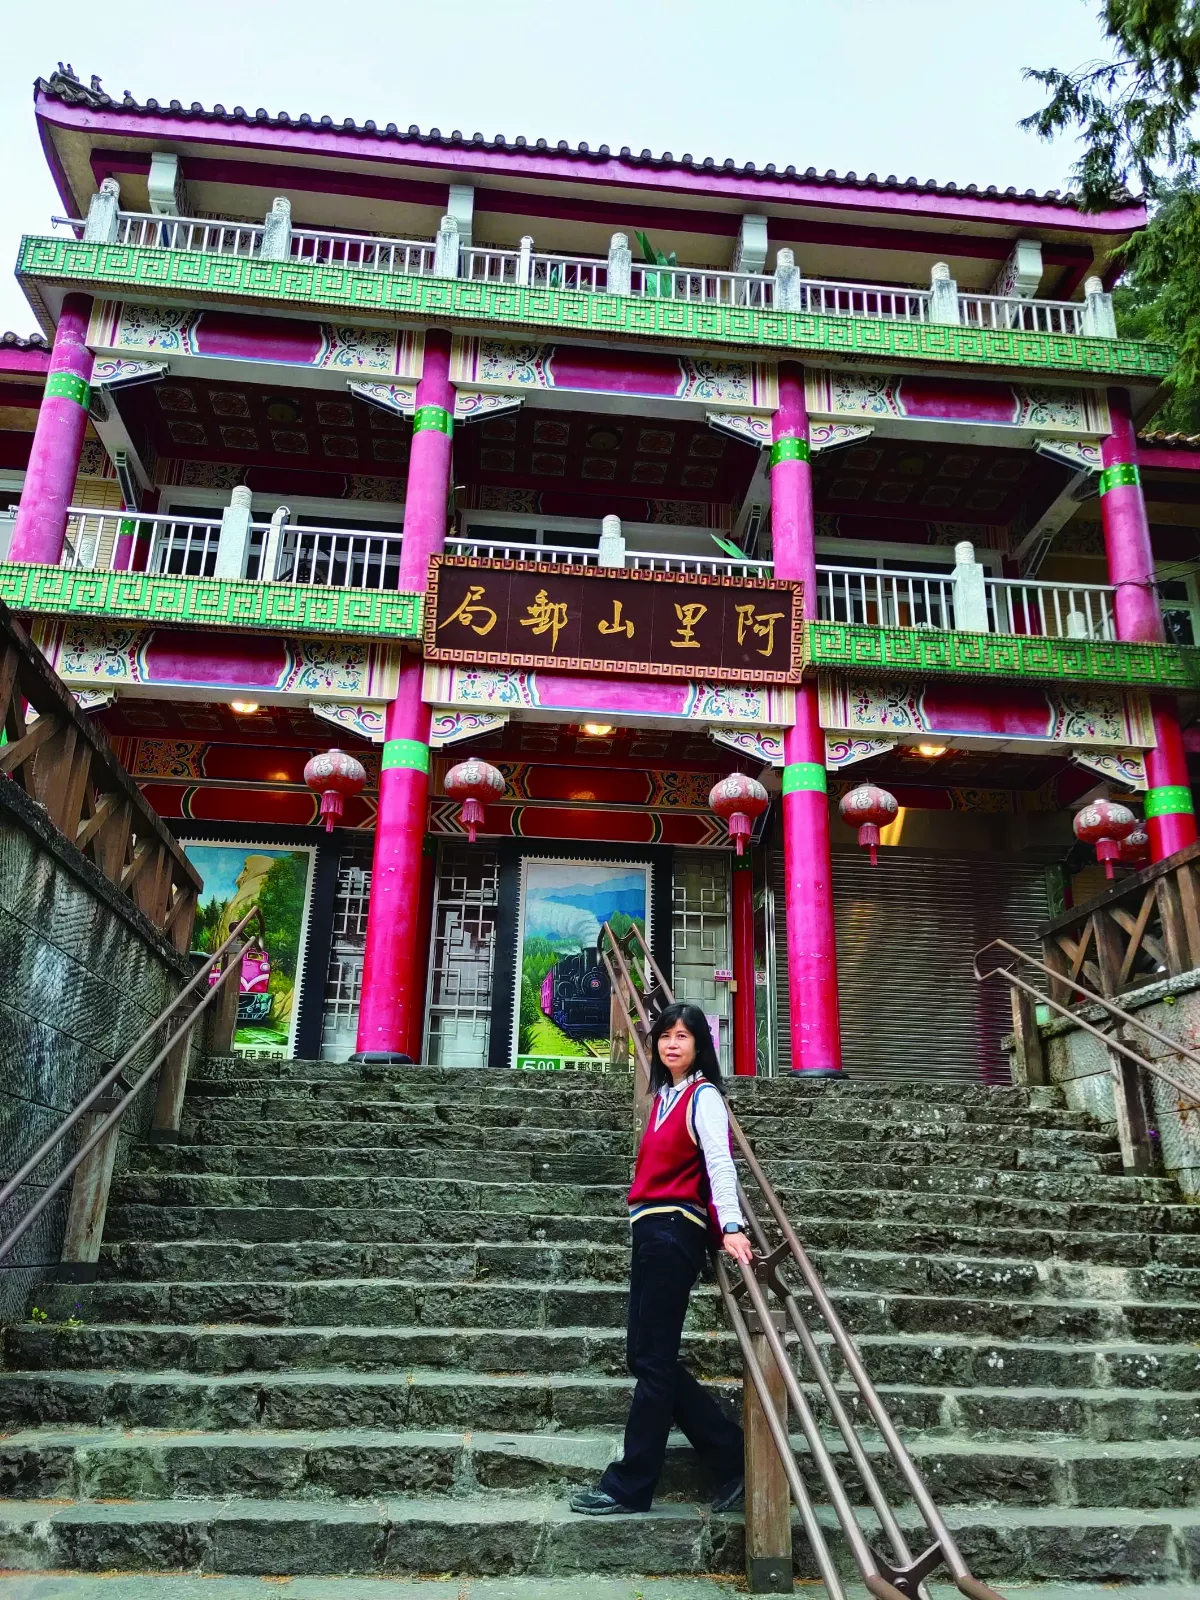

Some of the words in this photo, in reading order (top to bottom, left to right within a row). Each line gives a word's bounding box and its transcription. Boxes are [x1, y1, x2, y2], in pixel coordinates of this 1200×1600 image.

[438, 585, 785, 657] 阿里山郵局
